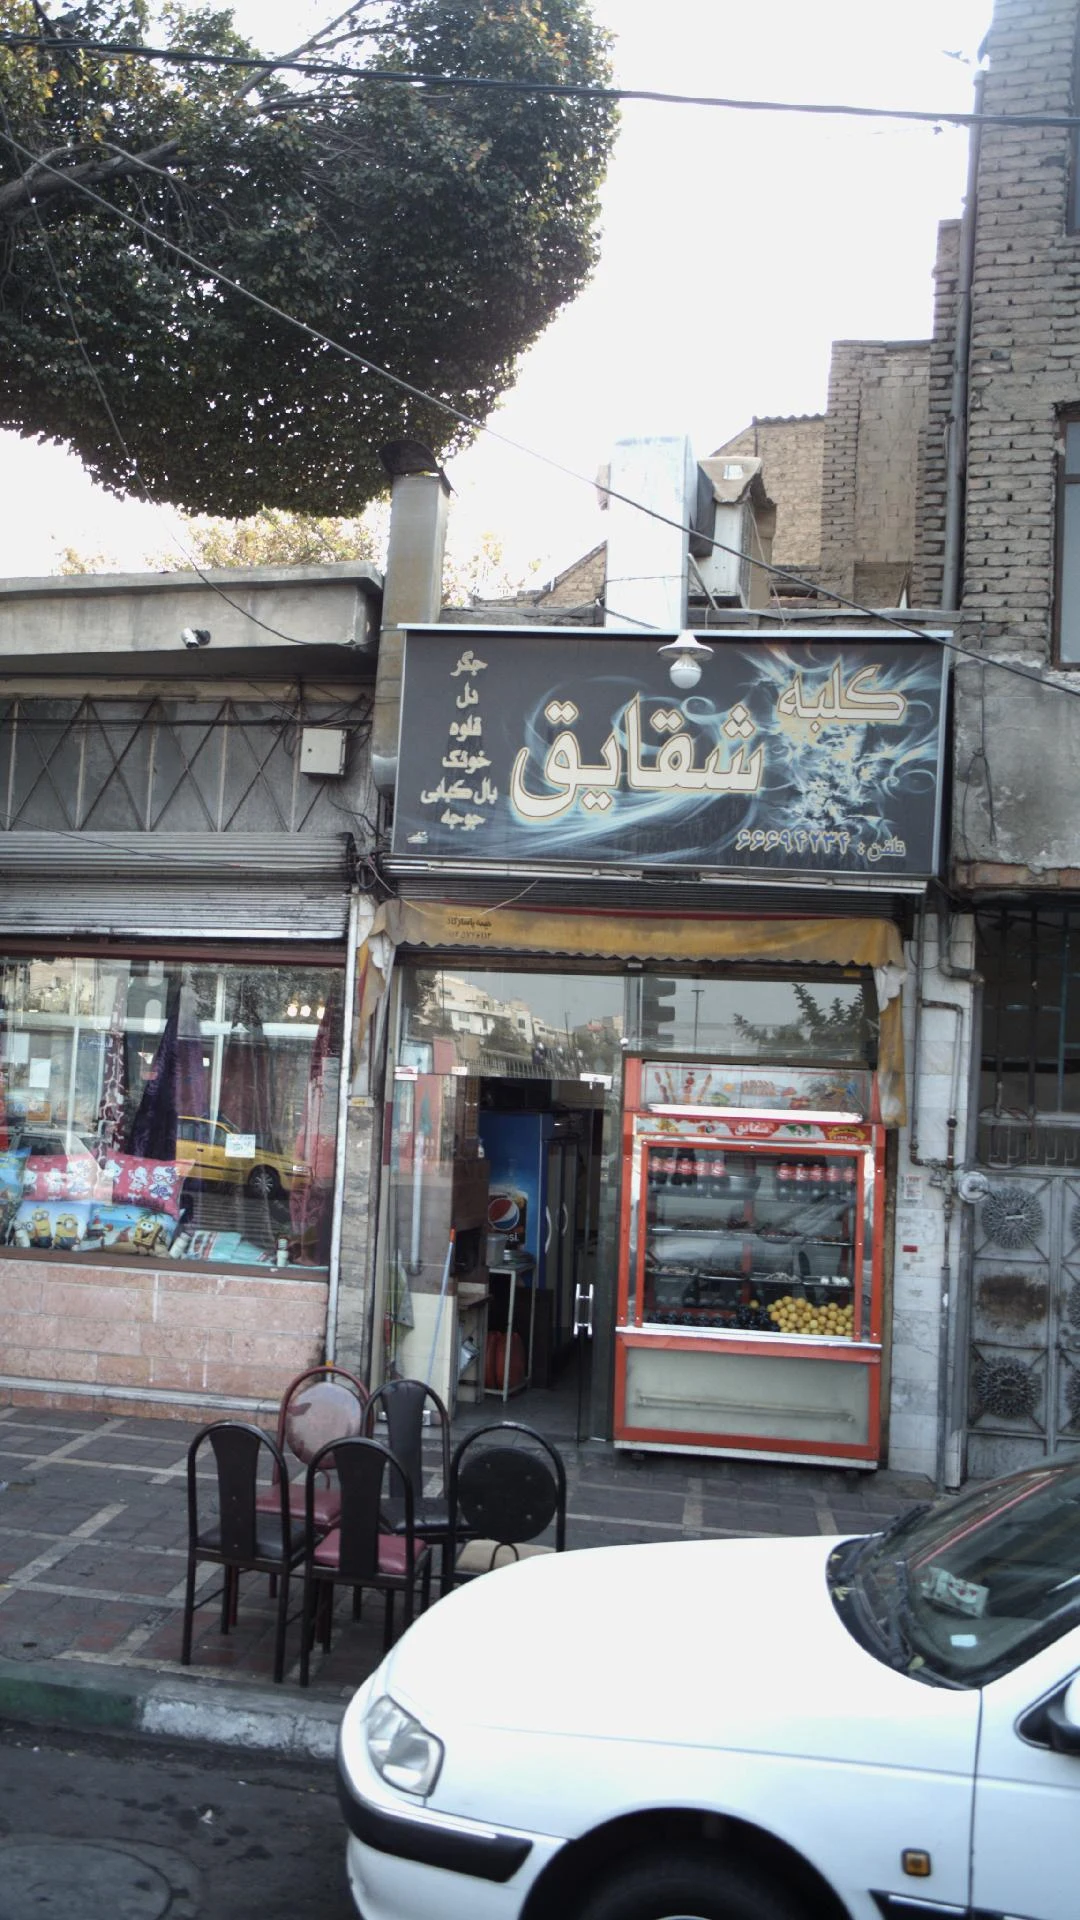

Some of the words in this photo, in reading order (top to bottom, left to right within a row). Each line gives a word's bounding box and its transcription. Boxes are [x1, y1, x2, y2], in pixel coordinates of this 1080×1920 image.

[450, 650, 488, 677] جگر
[456, 681, 479, 709] دل
[777, 656, 907, 734] کلبه
[449, 714, 482, 741] قلوه
[510, 692, 765, 820] شقایق
[420, 776, 473, 804] کبابی
[473, 776, 498, 805] بال
[441, 808, 486, 831] جوجه
